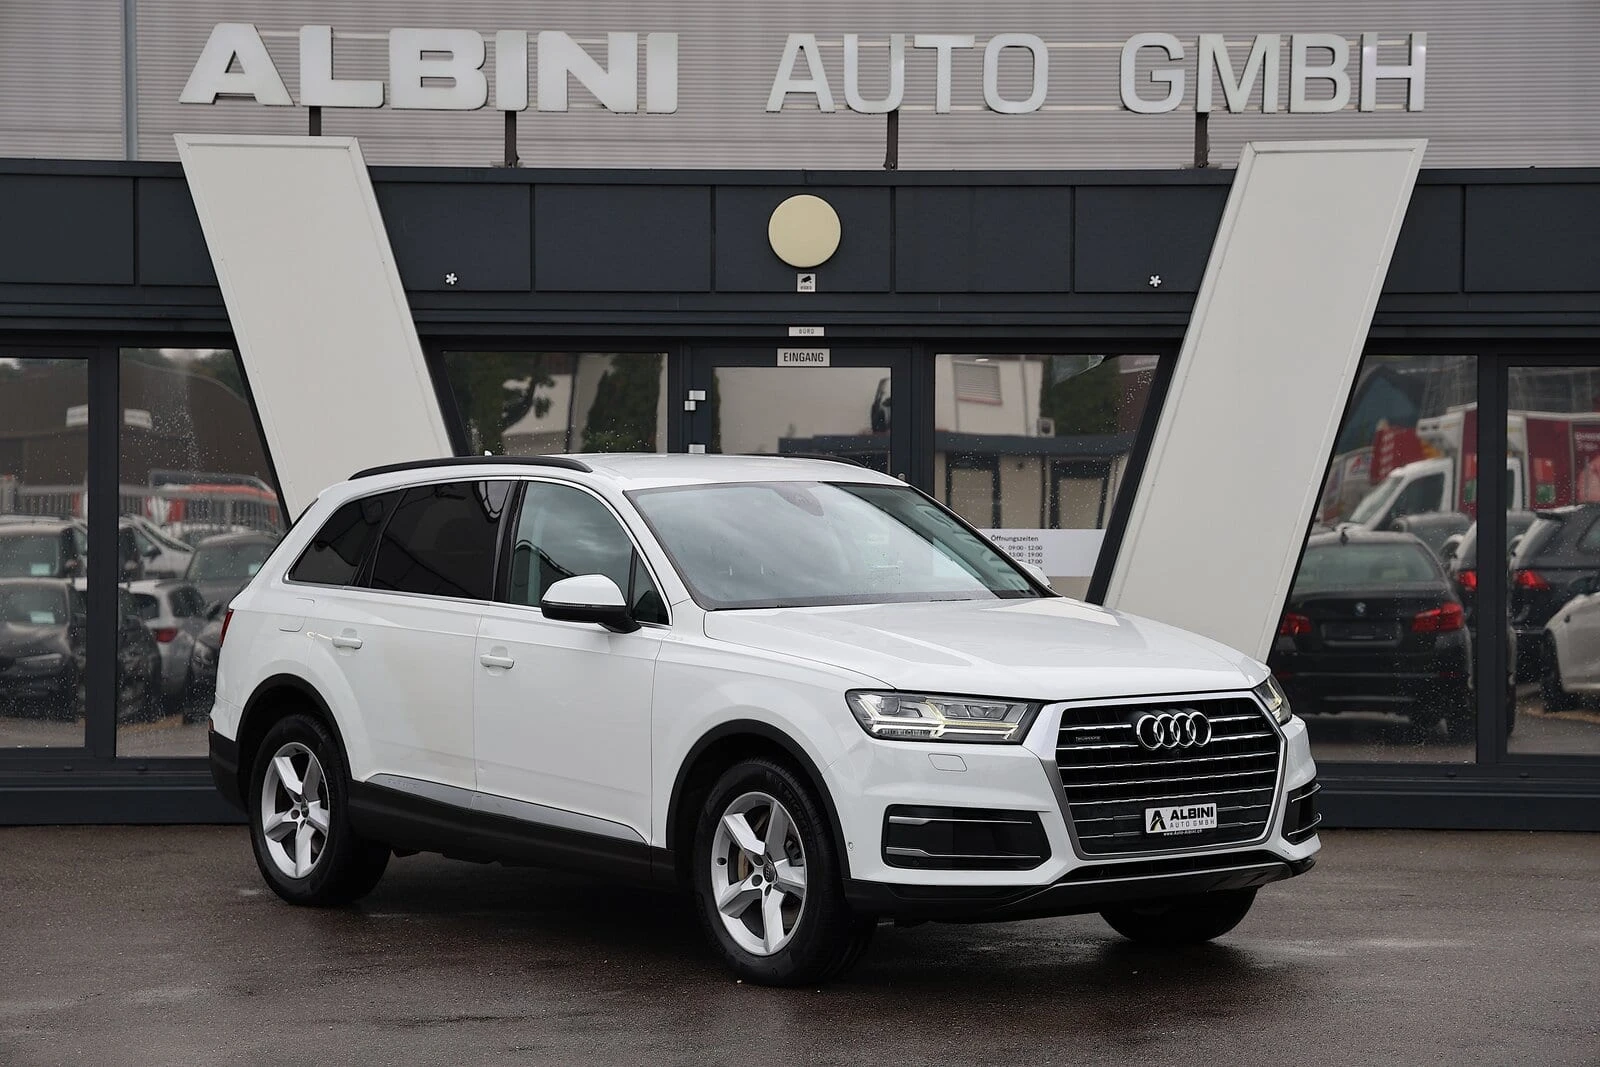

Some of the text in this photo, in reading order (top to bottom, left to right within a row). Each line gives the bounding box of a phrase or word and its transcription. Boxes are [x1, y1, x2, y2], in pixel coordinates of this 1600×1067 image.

[179, 22, 1427, 115] ALBINI AUTO GMBH
[783, 352, 824, 362] EINGANG
[1170, 807, 1214, 820] ALBINI
